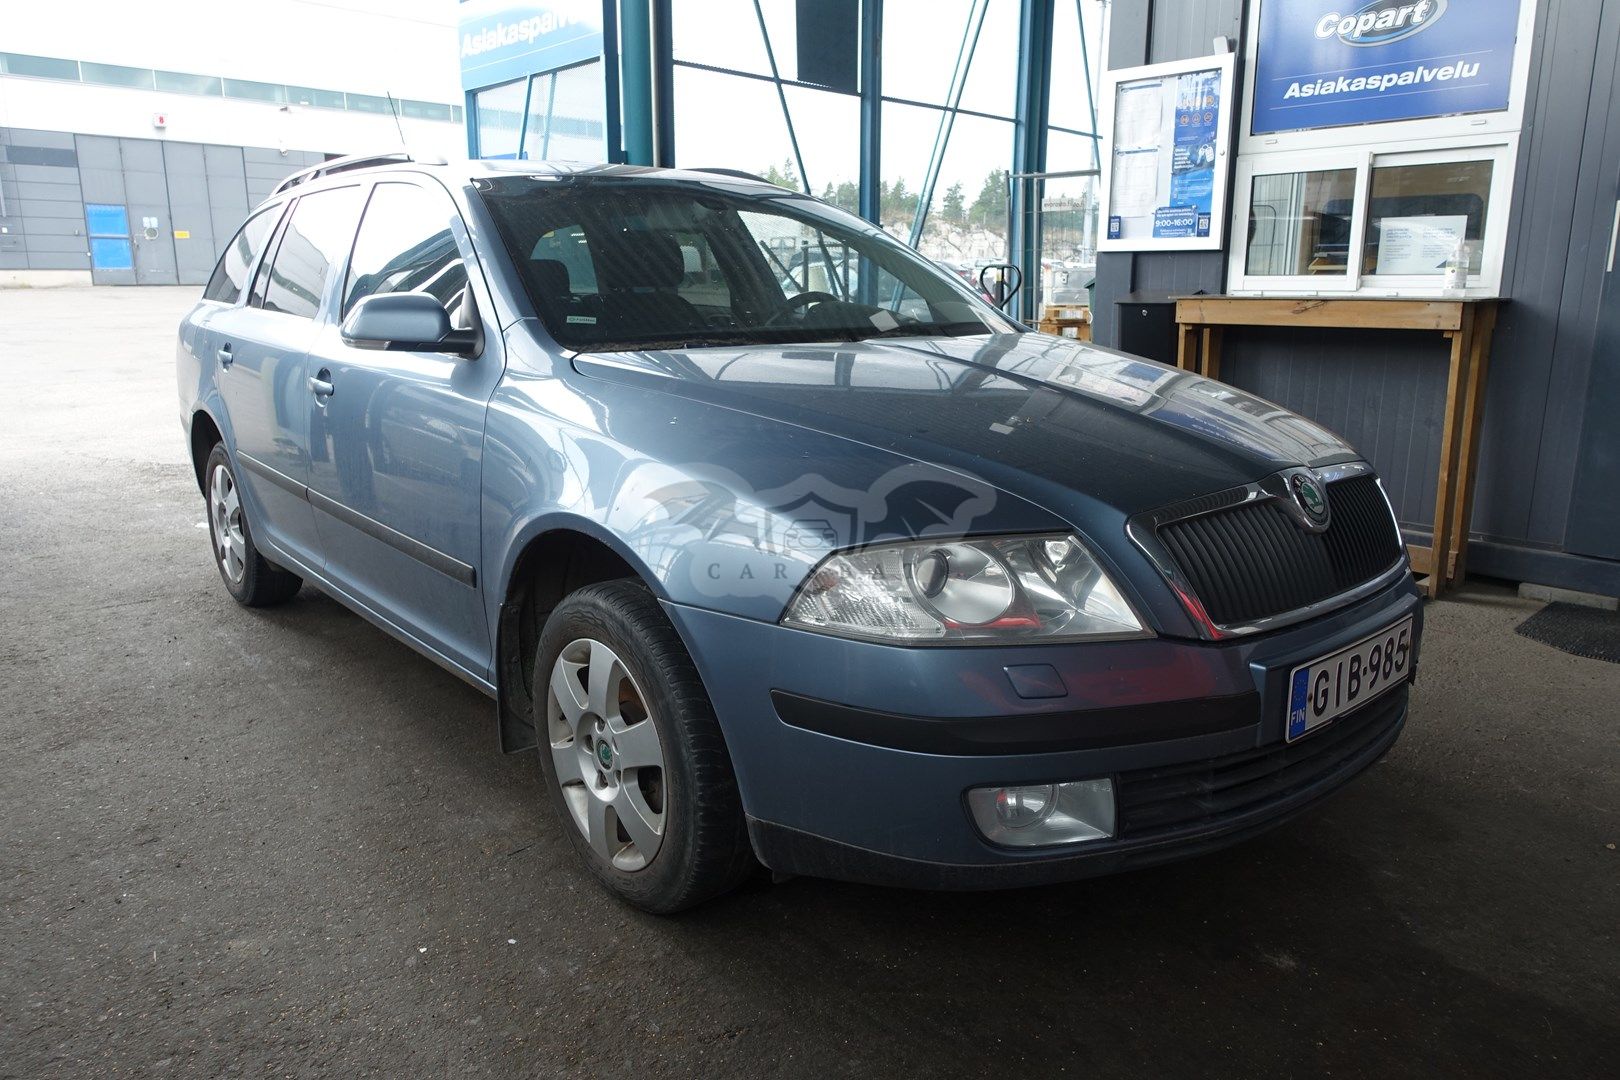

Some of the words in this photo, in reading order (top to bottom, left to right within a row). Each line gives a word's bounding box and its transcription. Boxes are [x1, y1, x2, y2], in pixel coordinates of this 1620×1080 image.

[1314, 0, 1431, 39] Copart
[1283, 61, 1480, 99] Asiakaspalvelu
[1155, 218, 1193, 227] 9:00-16:00
[1313, 628, 1409, 717] GIB-985
[1290, 707, 1306, 726] FIN
